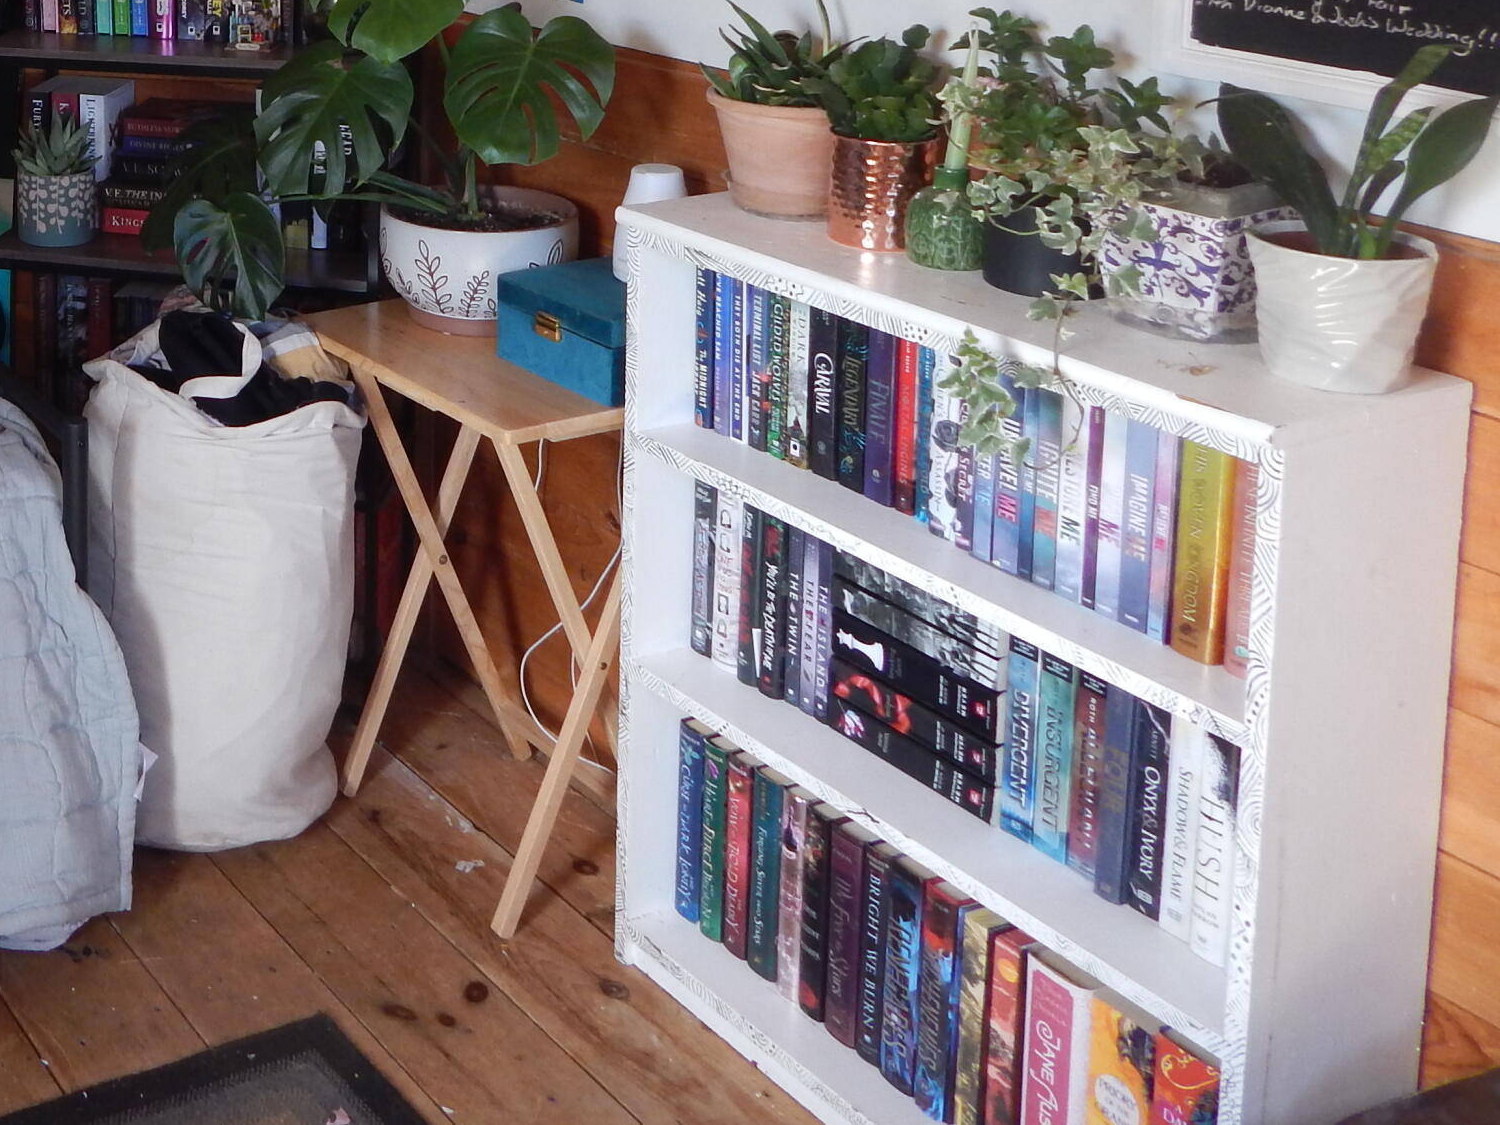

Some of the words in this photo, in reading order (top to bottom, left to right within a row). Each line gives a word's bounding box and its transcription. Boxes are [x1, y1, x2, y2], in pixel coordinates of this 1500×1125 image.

[130, 140, 155, 150] DIVINE
[696, 292, 708, 317] Haig
[714, 292, 722, 338] REACHED
[733, 295, 742, 317] THEY
[752, 294, 763, 341] TERMINAL
[733, 319, 742, 345] BOTH
[772, 303, 784, 352] GILDED
[796, 317, 807, 363] DARK
[714, 342, 722, 360] SAM
[733, 348, 742, 365] DIE
[752, 342, 761, 367] LIST
[698, 361, 708, 409] MIDNIGHT
[733, 367, 742, 379] AT
[733, 382, 742, 399] THE
[751, 371, 762, 397] JACK
[771, 354, 781, 403] WOLVES
[814, 353, 834, 415] CARAVAL
[841, 355, 862, 432] LEGENDARY
[733, 402, 742, 421] END
[751, 399, 761, 426] CARR
[869, 379, 891, 445] FINALE
[899, 439, 910, 485] ENGINES
[934, 451, 945, 505] ASSASSIN
[957, 455, 971, 502] SECRET
[1036, 440, 1059, 504] IGNITE
[997, 494, 1017, 523] ME
[1033, 506, 1056, 539] ME
[1127, 473, 1148, 536] IMAGINE
[1188, 478, 1205, 539] WOVEN
[1059, 515, 1081, 546] ME
[1098, 518, 1121, 549] ME
[1124, 533, 1145, 562] ME
[764, 561, 777, 590] YOU'LL
[788, 572, 798, 602] THE
[805, 579, 814, 607] THE
[1182, 543, 1203, 623] KINGDOM
[818, 585, 827, 619] THE
[763, 613, 776, 647] DEATH
[788, 615, 798, 656] TWIN
[803, 623, 814, 663] FEAR
[763, 654, 773, 671] ME
[816, 626, 827, 690] ISLAND
[960, 686, 968, 717] MEYER
[1088, 697, 1097, 723] ROTH
[1008, 688, 1031, 808] DIVERGENT
[679, 764, 693, 798] CURSE
[954, 772, 964, 804] MEYER
[1041, 705, 1063, 835] INSURGENT
[1102, 747, 1128, 816] FOUR
[1142, 764, 1161, 815] ONYX
[702, 780, 717, 818] HEART
[1173, 765, 1194, 837] SHADOW
[680, 812, 691, 855] DARK
[1142, 814, 1155, 830] &
[702, 823, 716, 870] FIERCE
[756, 825, 768, 867] FORGING
[1138, 828, 1157, 882] IVORY
[1195, 794, 1225, 902] HUSH
[677, 858, 692, 901] LONELY
[755, 869, 766, 897] SILVER
[1169, 849, 1187, 903] FLAME
[829, 898, 850, 935] Free
[867, 873, 882, 944] BRIGHT
[753, 918, 765, 946] STARS
[829, 949, 850, 997] Stars
[866, 949, 878, 974] WE
[863, 978, 877, 1031] BURN
[883, 917, 913, 1056] RENEGADES
[918, 945, 943, 1071] ARCHENEMIES
[1034, 1019, 1062, 1087] JANE
